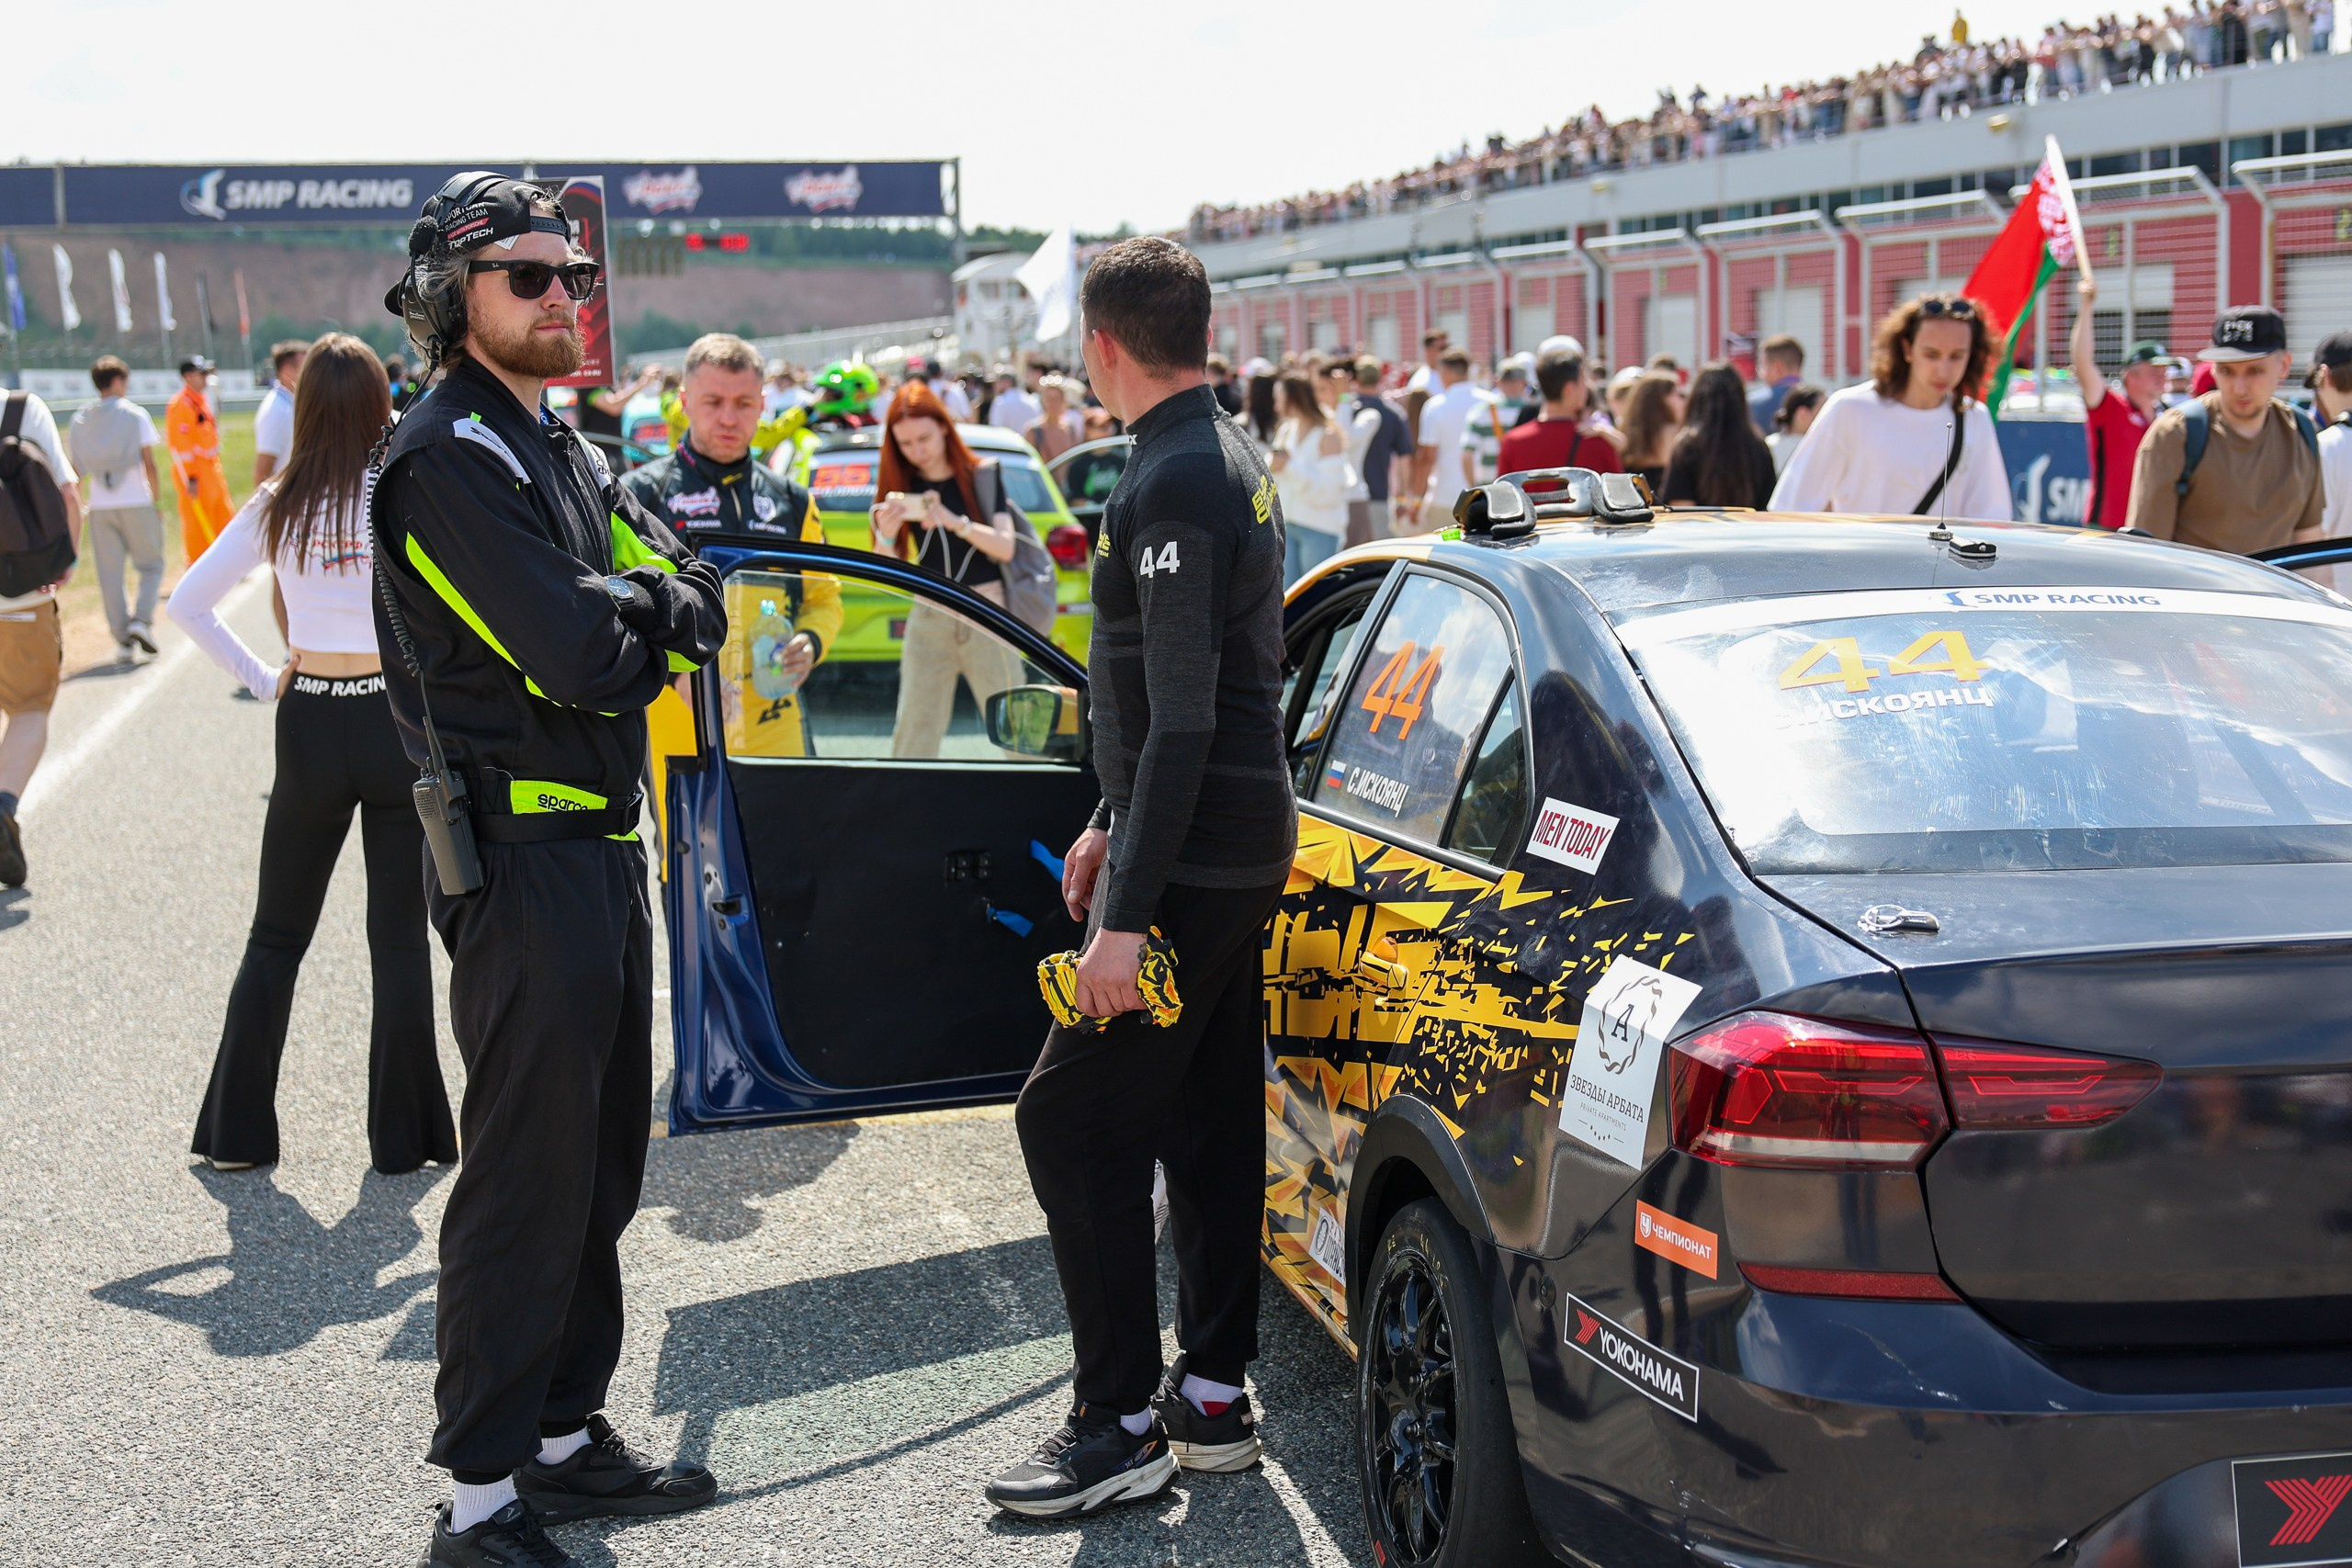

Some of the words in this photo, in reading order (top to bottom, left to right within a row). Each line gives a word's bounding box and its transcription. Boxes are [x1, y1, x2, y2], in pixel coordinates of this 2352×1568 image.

[225, 180, 296, 209] SMP
[296, 178, 413, 209] RACING
[445, 215, 467, 231] RACING
[466, 208, 489, 220] TEAM
[2046, 476, 2092, 523] SM
[1140, 541, 1180, 579] 44
[1973, 593, 2041, 604] SMP
[2046, 593, 2161, 605] RACING
[1778, 630, 1990, 694] 44
[294, 675, 330, 695] SMP
[331, 675, 386, 696] RACIN
[1361, 640, 1446, 740] 44
[1346, 766, 1410, 818] С.ИСКОЯНЦ
[1532, 810, 1569, 848] MEN
[1561, 818, 1611, 860] TODAY
[1570, 1074, 1606, 1104] ЗВЕЗДЫ
[1606, 1091, 1644, 1123] АРБАТА
[1580, 1102, 1598, 1117] PRIVATE
[1598, 1111, 1627, 1131] APARTMENTS
[1652, 1223, 1712, 1259] ЧЕМПИОНАТ
[1600, 1326, 1684, 1402] YOKOHAMA
